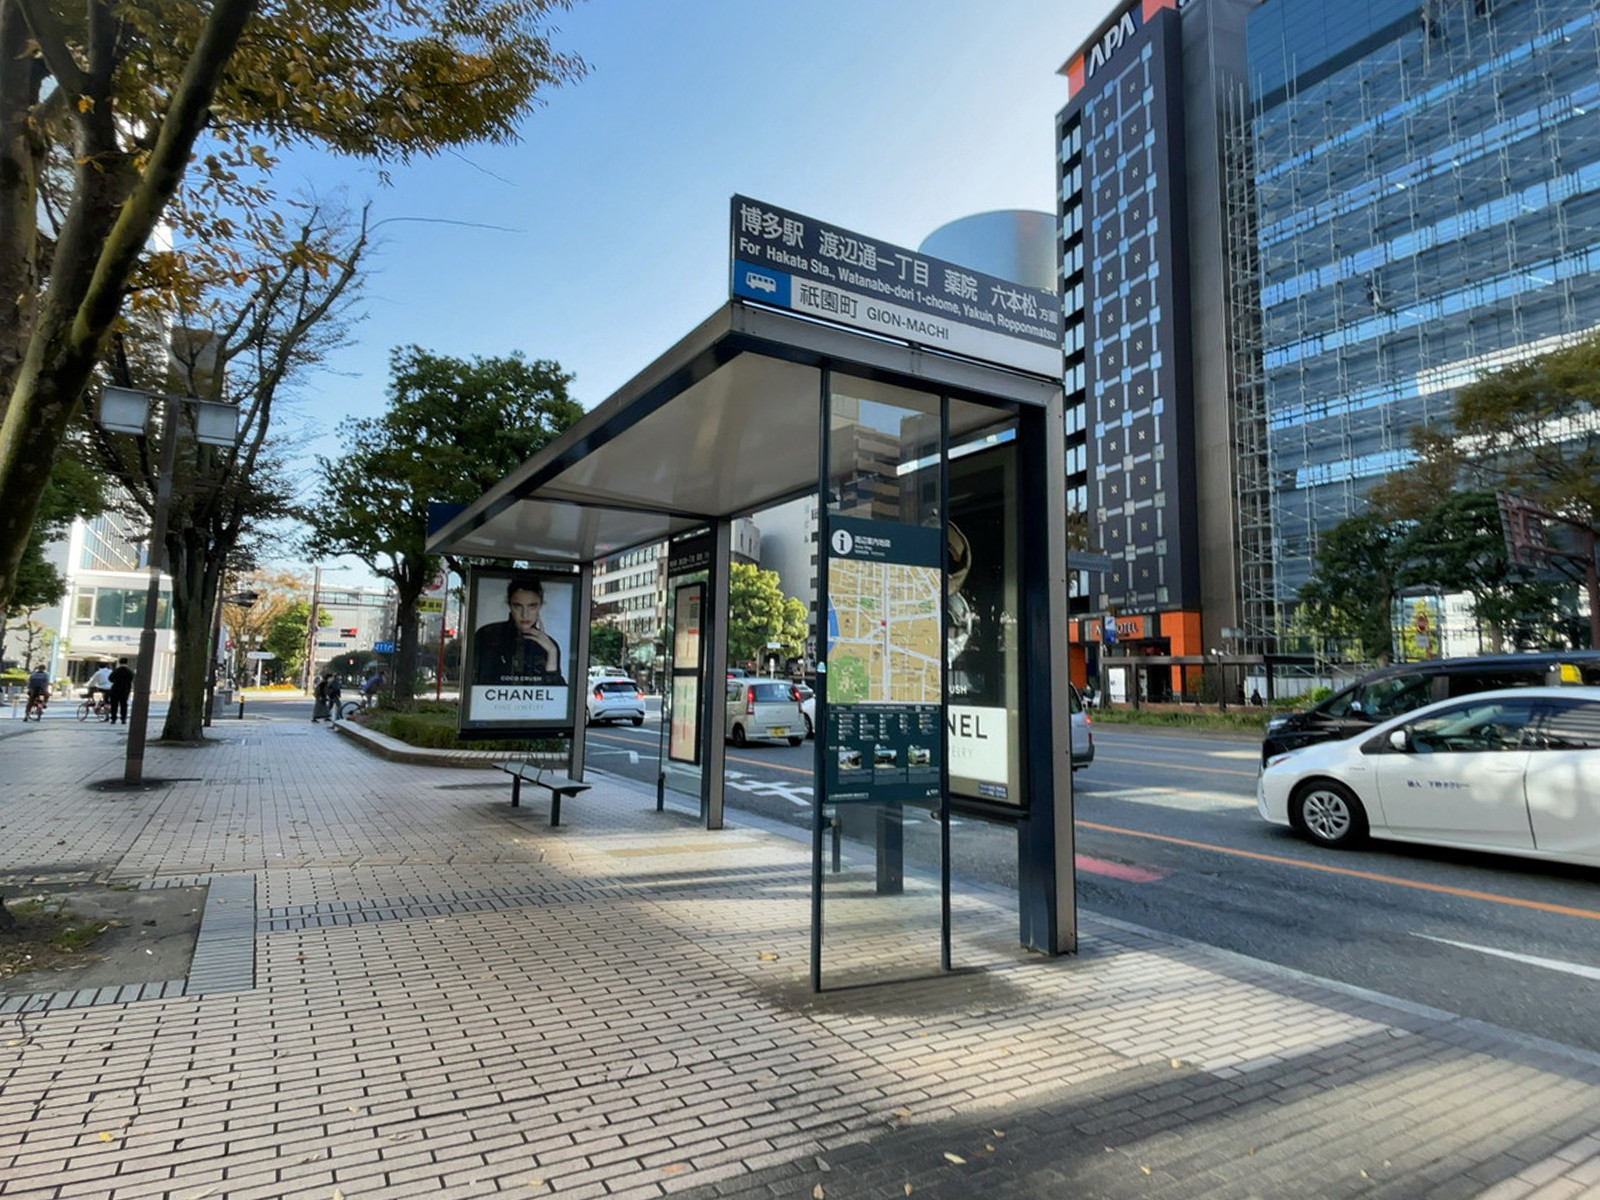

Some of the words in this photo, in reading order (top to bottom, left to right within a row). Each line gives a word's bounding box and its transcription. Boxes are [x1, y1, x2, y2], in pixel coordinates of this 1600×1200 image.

[1089, 11, 1136, 78] APA
[740, 203, 804, 249] 博多駅
[819, 229, 929, 288] 渡辺通一丁目
[944, 269, 978, 302] 薬院
[991, 285, 1037, 319] 六本松
[1039, 308, 1058, 325] 方面
[740, 237, 761, 256] For
[766, 245, 808, 271] Hakata
[838, 266, 914, 301] Watanabe-dori
[916, 290, 961, 316] 1-chome,
[963, 303, 996, 327] Yakuin,
[998, 313, 1058, 342] Ropponmatsu
[867, 306, 949, 341] GION-MACHI
[484, 689, 554, 701] CHANEL
